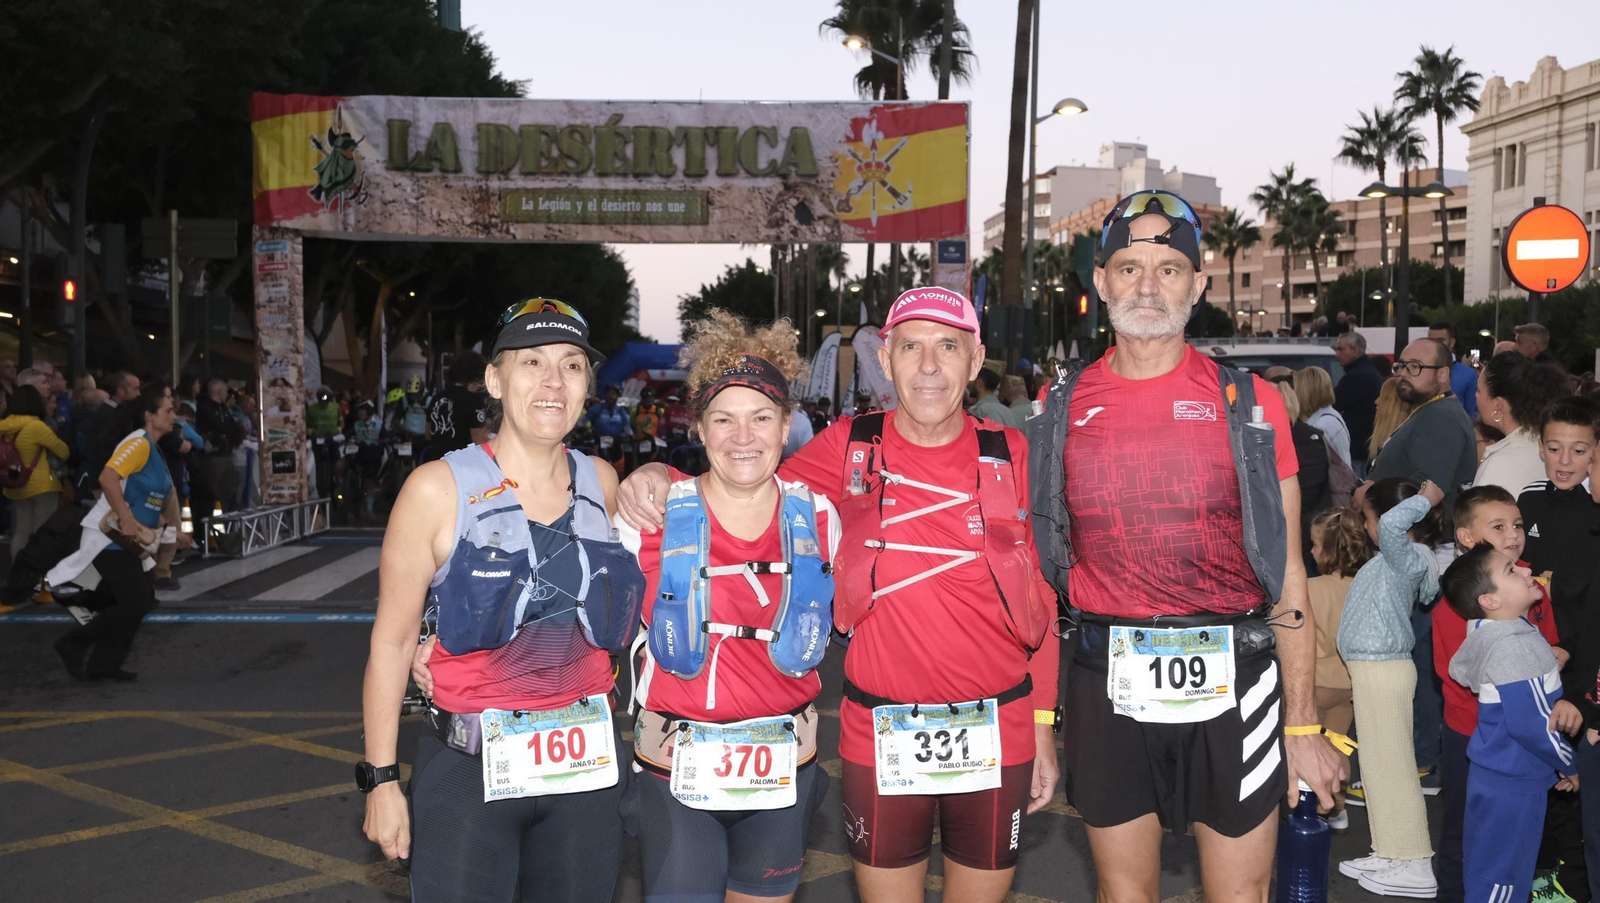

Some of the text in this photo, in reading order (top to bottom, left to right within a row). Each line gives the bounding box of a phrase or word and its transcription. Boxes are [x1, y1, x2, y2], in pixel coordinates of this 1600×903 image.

[385, 113, 820, 177] LA DESÉRTICA
[521, 197, 686, 214] La Legión y el desierto nos une
[919, 293, 962, 307] AONIJIE
[526, 321, 582, 336] SALOMON
[665, 619, 675, 658] AONIJIE
[801, 625, 819, 661] AONIJIE
[1149, 656, 1206, 689] 109
[1185, 687, 1215, 697] DOMINGO
[527, 727, 586, 765] 160
[914, 728, 969, 763] 331
[569, 759, 597, 769] JANA92
[713, 744, 773, 778] 370
[938, 760, 983, 769] PABLO RUBIO
[496, 777, 510, 785] BUS
